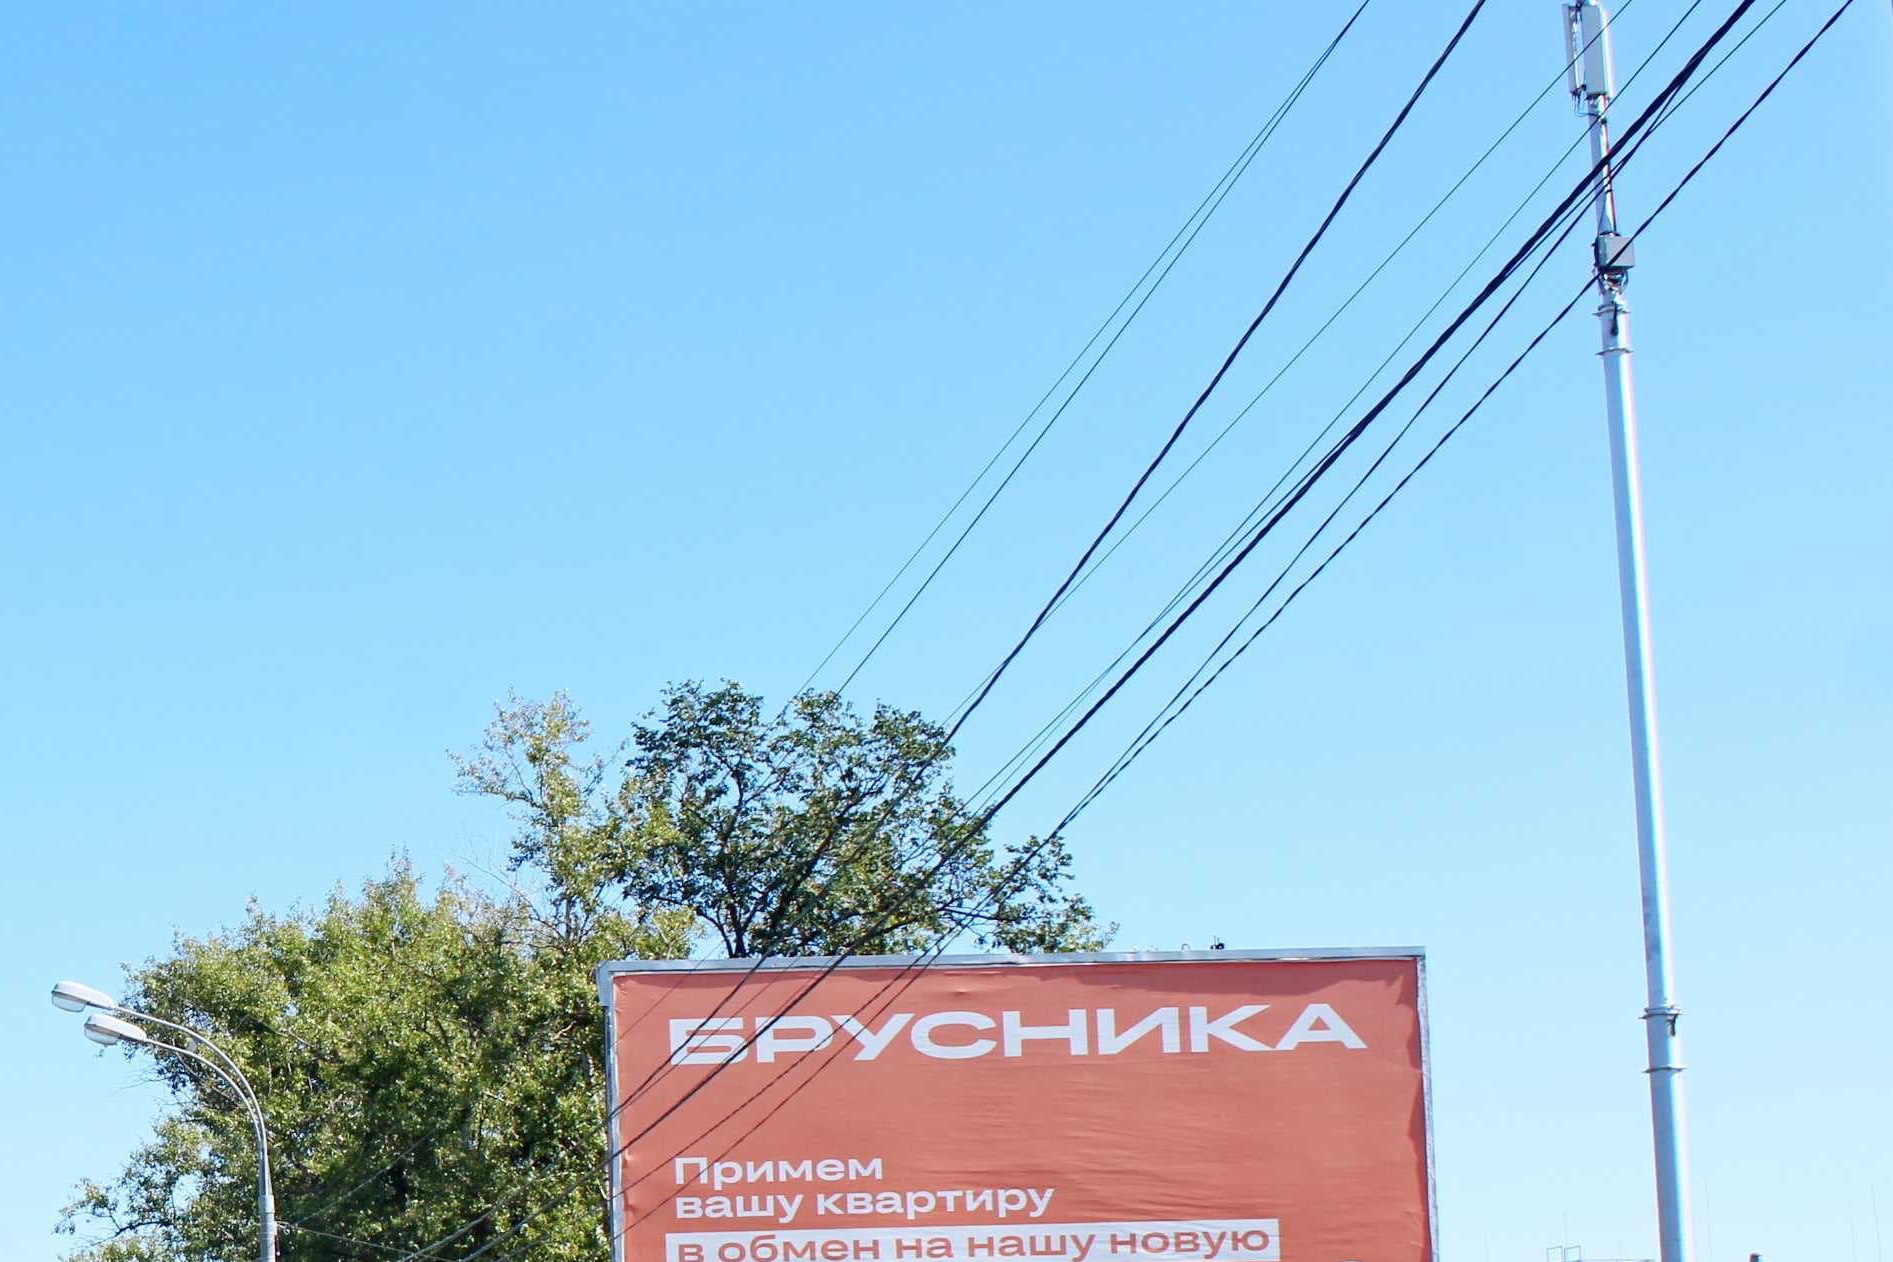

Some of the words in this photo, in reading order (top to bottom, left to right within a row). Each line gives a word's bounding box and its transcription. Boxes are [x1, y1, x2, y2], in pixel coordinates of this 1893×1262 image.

[669, 1003, 1368, 1065] БРУСНИКА
[674, 1156, 883, 1190] Примем
[675, 1193, 804, 1223] вашу
[817, 1187, 1055, 1219] квартиру
[894, 1232, 955, 1260] на
[967, 1233, 1096, 1262] нашу
[1109, 1229, 1270, 1260] новую
